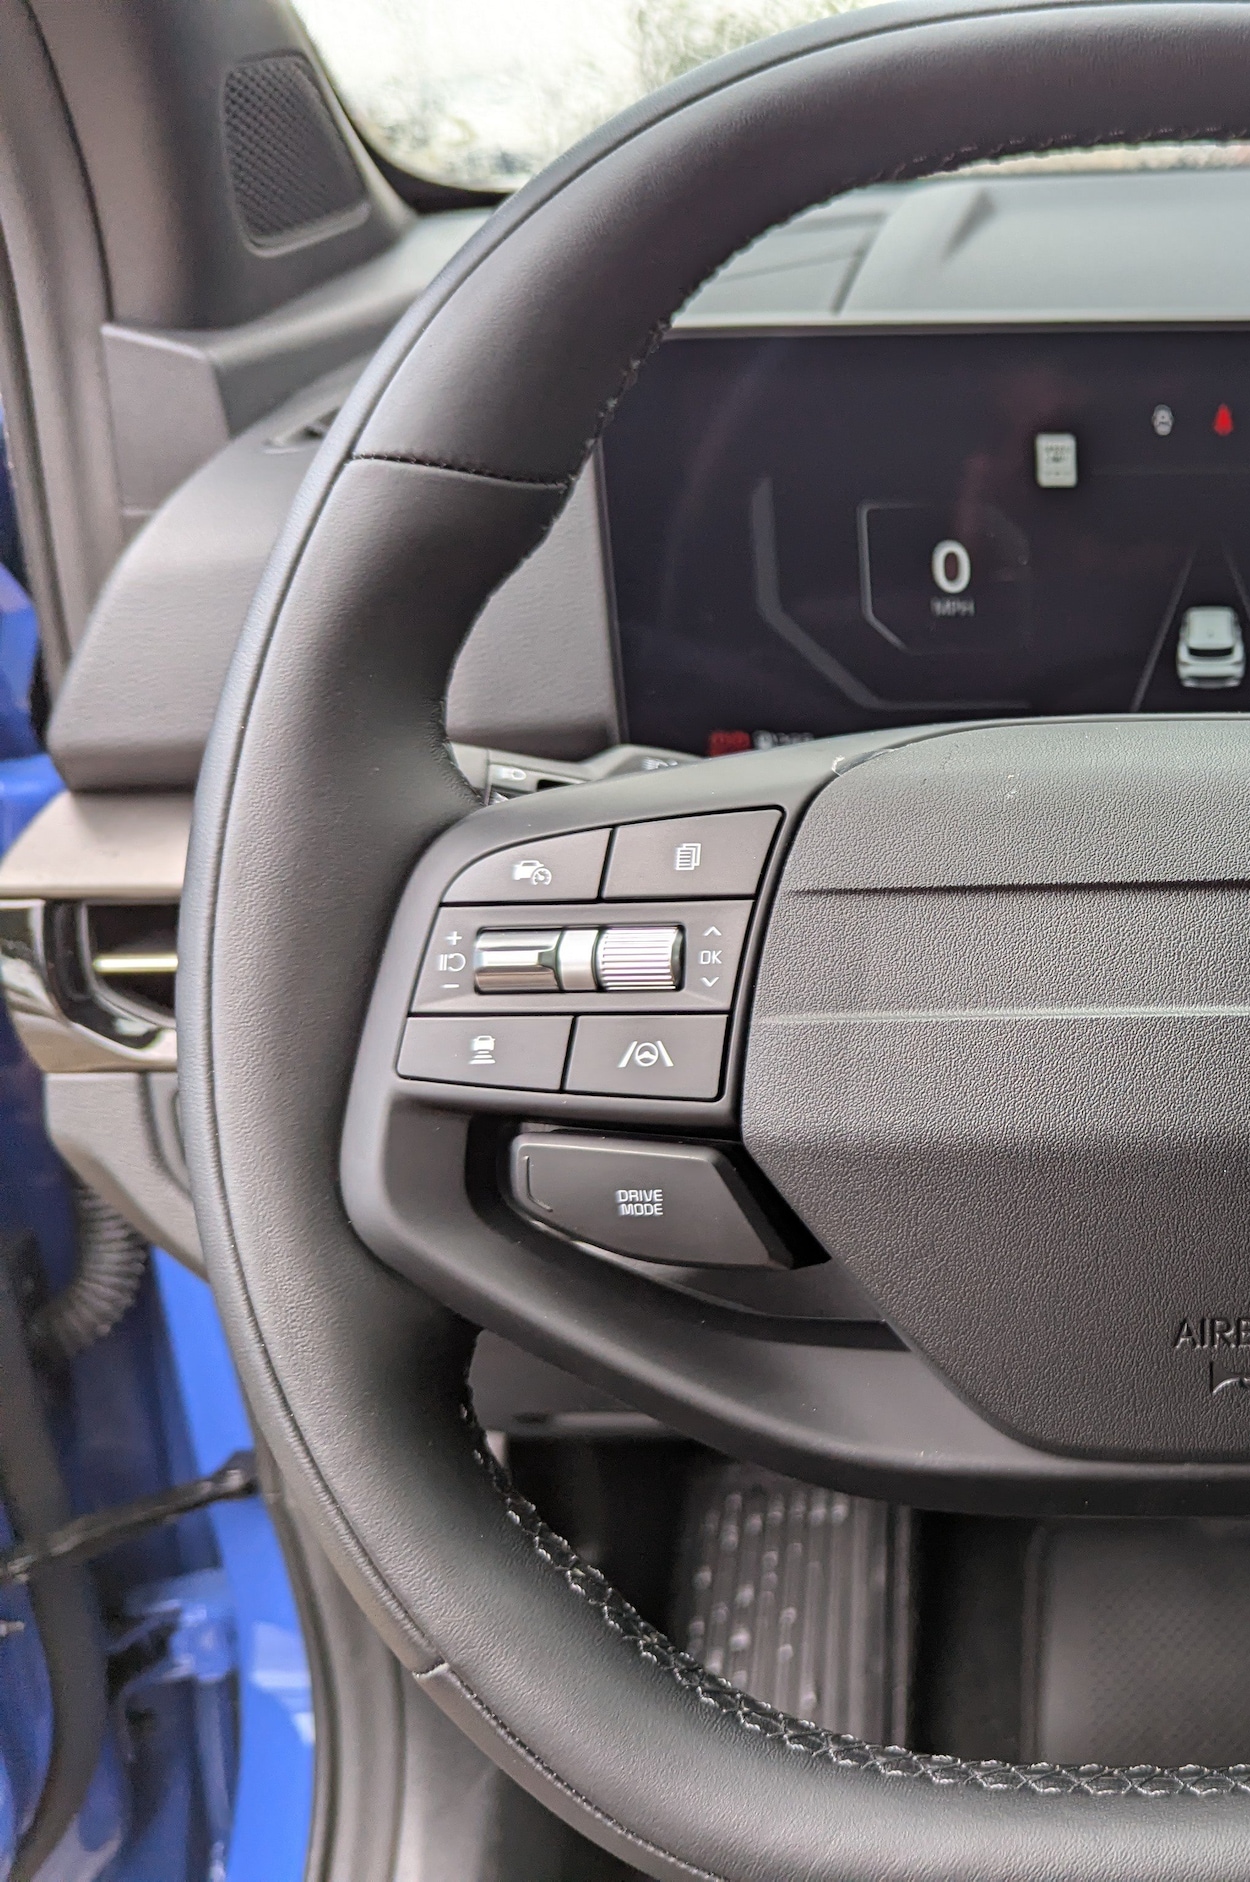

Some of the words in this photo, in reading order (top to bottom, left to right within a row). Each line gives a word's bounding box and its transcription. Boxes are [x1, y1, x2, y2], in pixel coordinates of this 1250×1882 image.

[932, 540, 971, 594] 0
[700, 950, 723, 966] OK
[616, 1189, 664, 1203] DRIVE
[619, 1203, 664, 1217] MODE
